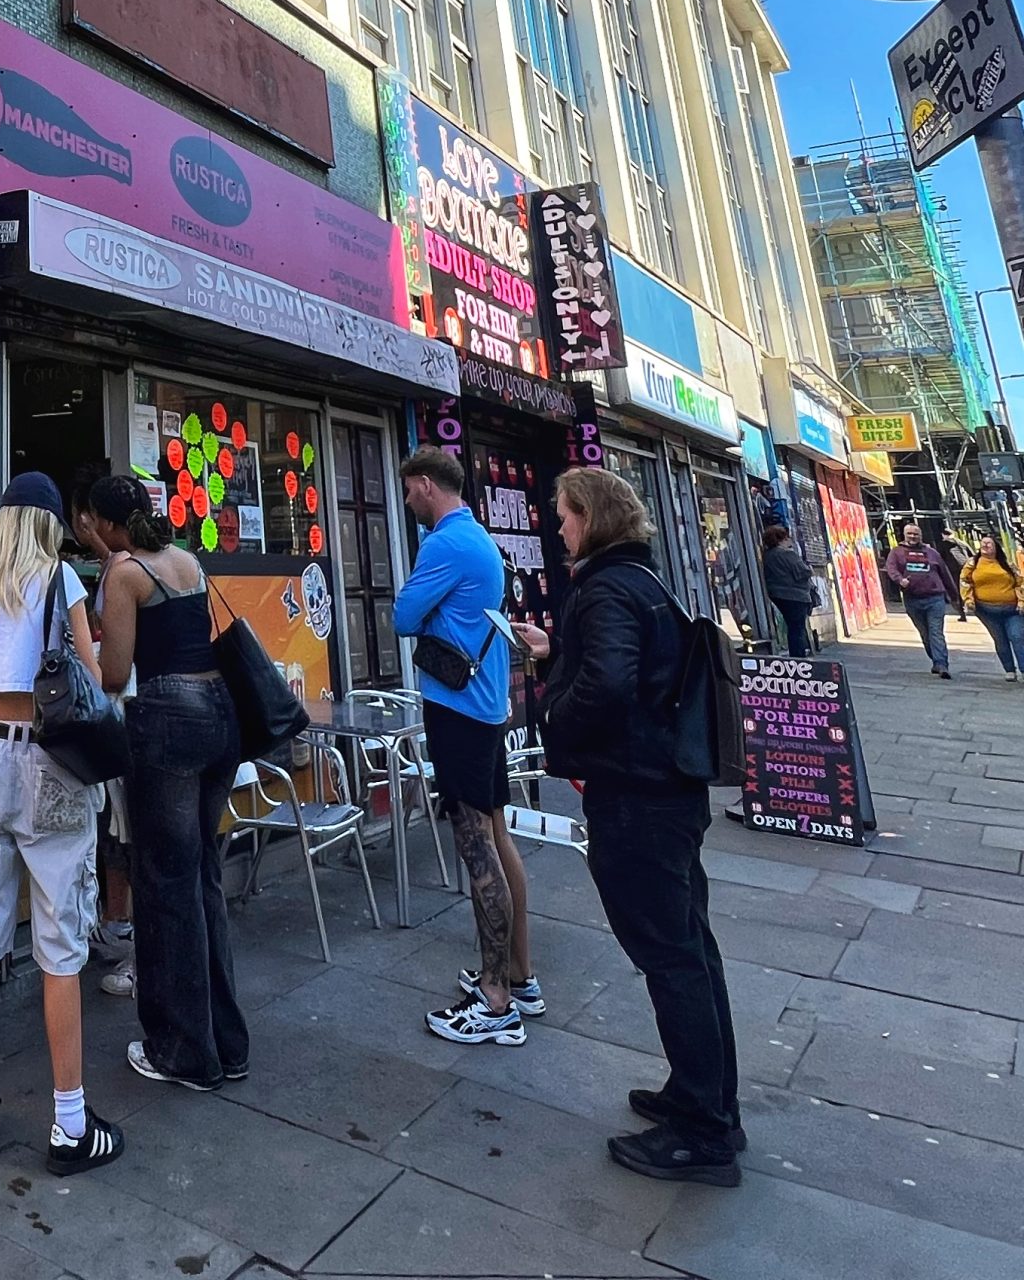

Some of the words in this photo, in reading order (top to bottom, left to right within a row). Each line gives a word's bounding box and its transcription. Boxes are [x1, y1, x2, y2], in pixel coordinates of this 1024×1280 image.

[4, 103, 132, 177] MANCHESTER
[175, 153, 248, 209] RUSTICA
[171, 214, 209, 244] FRESH
[211, 233, 221, 247] &
[223, 235, 255, 261] TASTY
[84, 233, 171, 285] RUSTICA
[424, 227, 488, 294] ADULT
[491, 264, 536, 317] SHOP
[187, 287, 216, 309] HOT
[219, 299, 228, 313] &
[231, 301, 267, 326] COLD
[455, 287, 487, 329] FOR
[485, 301, 520, 344] HIM
[445, 312, 459, 342] 18
[470, 328, 483, 355] &
[482, 333, 514, 368] HER
[641, 358, 679, 414] Vinyl
[675, 374, 723, 430] Revival
[857, 418, 904, 430] FRESH
[862, 430, 903, 442] BITES
[740, 694, 792, 710] ADULT
[797, 699, 841, 714] SHOP
[743, 719, 754, 731] 18
[753, 709, 790, 725] FOR
[792, 712, 830, 728] HIM
[766, 724, 779, 737] &
[782, 725, 818, 740] HER
[830, 728, 845, 740] 18
[765, 750, 825, 766] LOTIONS
[765, 762, 827, 778] POTIONS
[779, 776, 816, 790] PILLS
[768, 787, 830, 804] POPPERS
[751, 802, 763, 813] 18
[769, 799, 833, 816] CLOTHES
[752, 814, 797, 832] OPEN
[797, 813, 810, 834] 7
[810, 823, 854, 840] DAYS
[840, 815, 852, 825] 18
